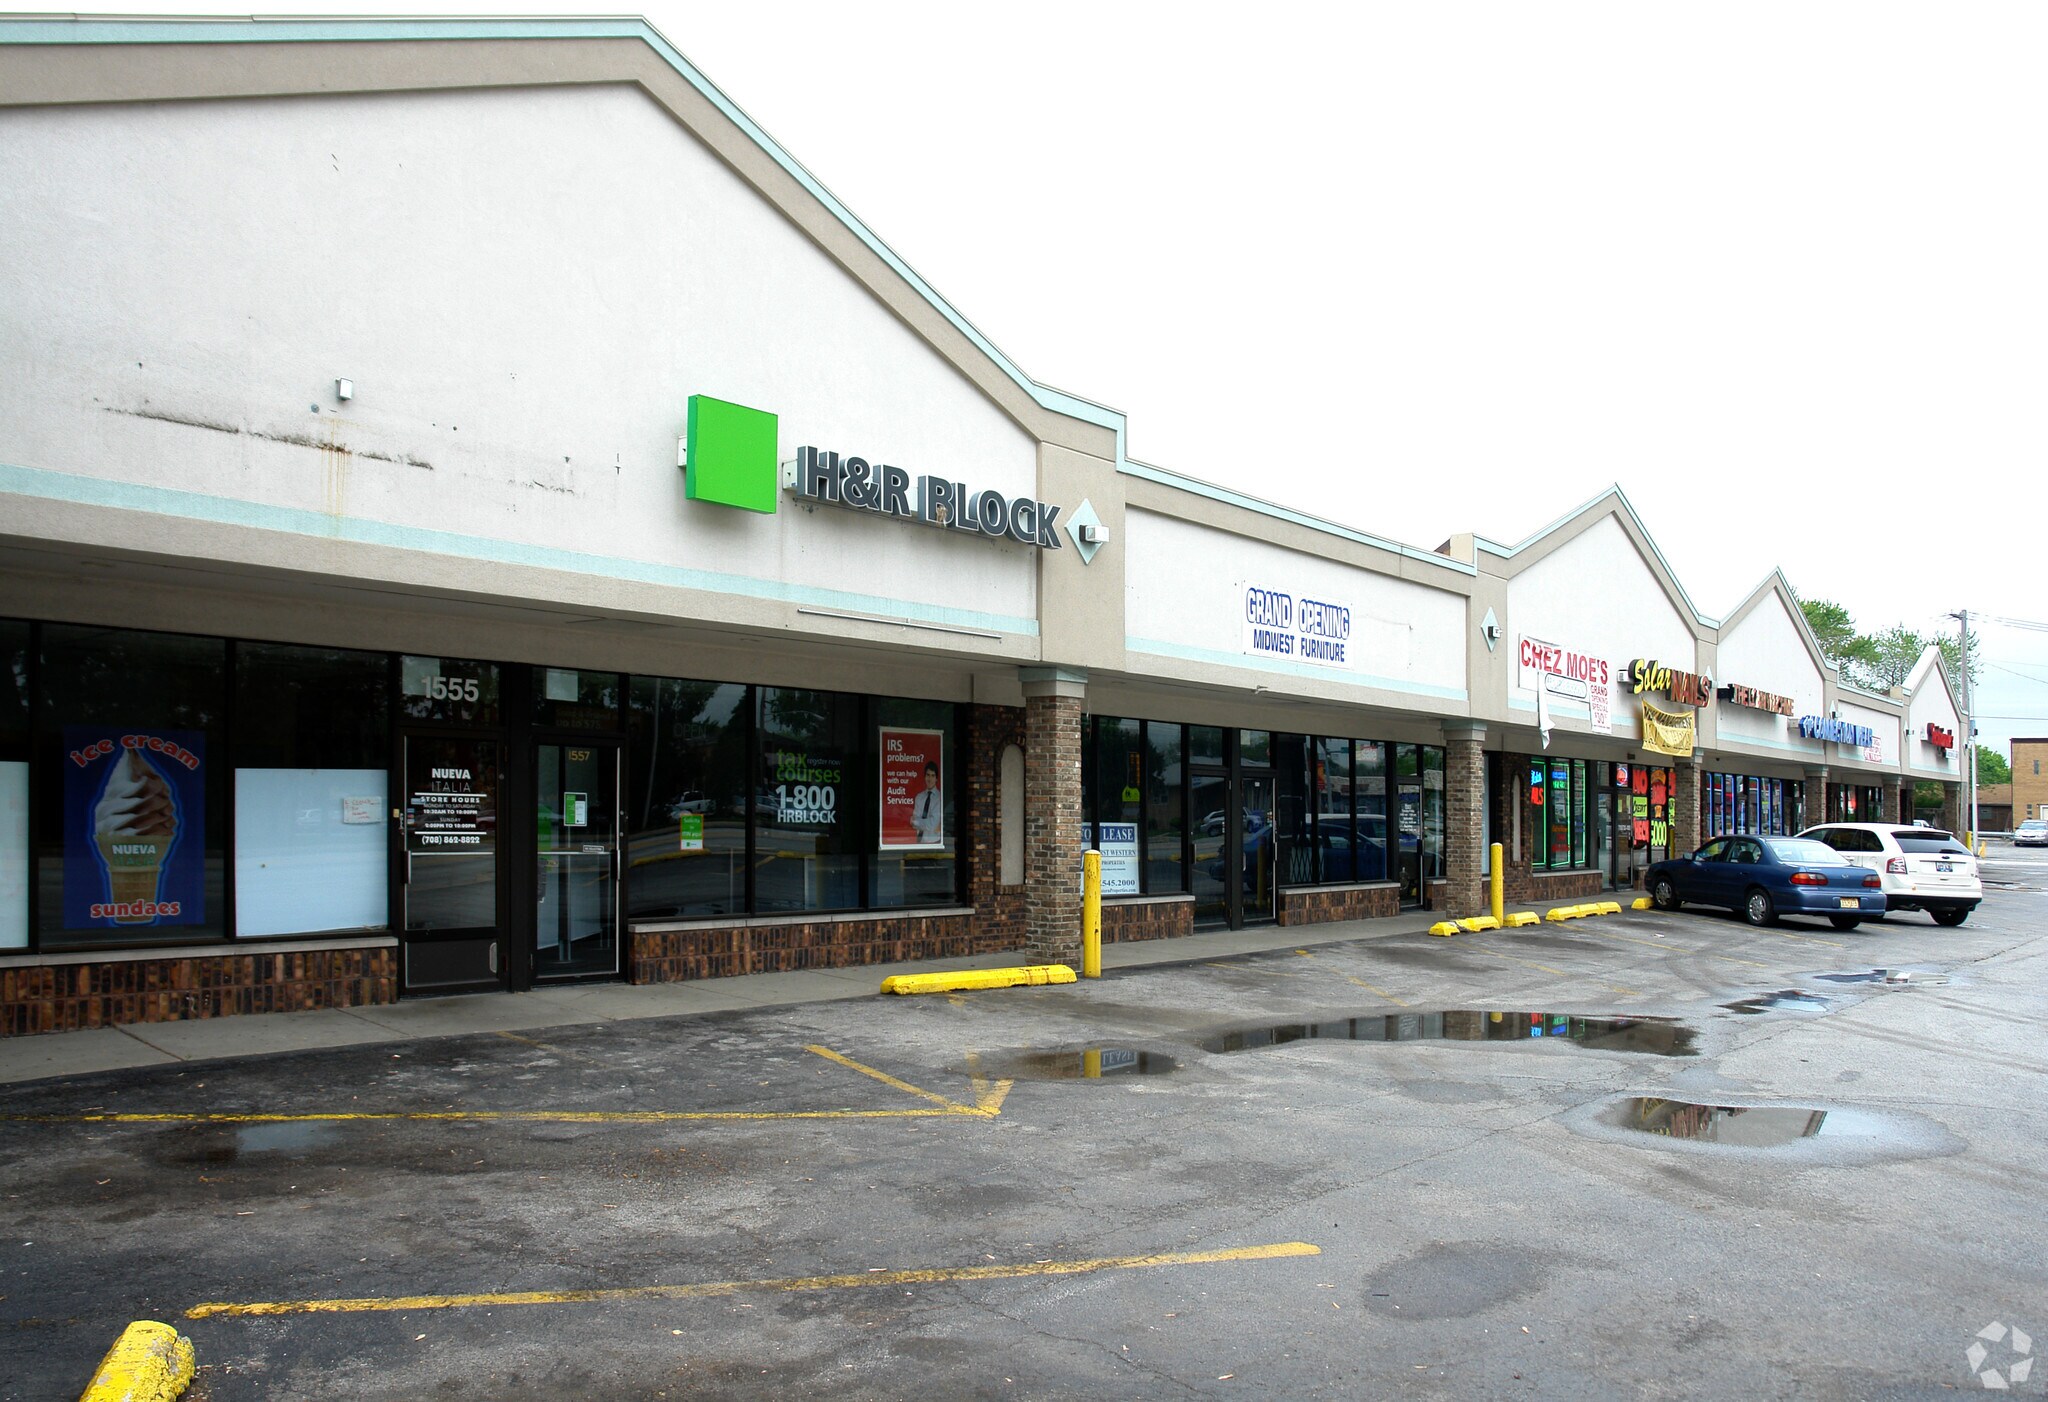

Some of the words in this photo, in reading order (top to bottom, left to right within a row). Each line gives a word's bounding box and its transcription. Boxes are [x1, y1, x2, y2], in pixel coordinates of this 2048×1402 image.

[797, 445, 912, 517] H&R
[918, 474, 1063, 550] BLOCK
[1246, 587, 1292, 629] GRAND
[1298, 599, 1350, 640] OPENING
[1253, 628, 1295, 655] MIDWEST
[1300, 637, 1345, 663] FURNITURE
[1520, 640, 1562, 675] CHEZ
[1566, 651, 1608, 685] MOE'S
[421, 675, 480, 702] 1555
[1628, 658, 1672, 695] Solar
[1667, 669, 1712, 708] NAILS
[70, 739, 115, 768] ice
[120, 734, 200, 770] cream
[886, 738, 904, 752] IRS
[568, 750, 590, 761] 1557
[777, 749, 807, 768] tax
[886, 753, 925, 764] problems?
[431, 767, 472, 780] NUEVA
[776, 766, 841, 784] courses
[905, 770, 917, 778] help
[431, 780, 472, 793] ITALIA
[886, 786, 906, 795] Audit
[451, 796, 480, 804] HOURS
[775, 784, 836, 810] 1-800
[886, 796, 914, 805] Services
[777, 809, 837, 823] HRBLOCK
[421, 835, 442, 845] (708)
[1103, 828, 1134, 840] LEASE
[111, 844, 156, 855] NUEVA
[90, 898, 180, 918] sundaes
